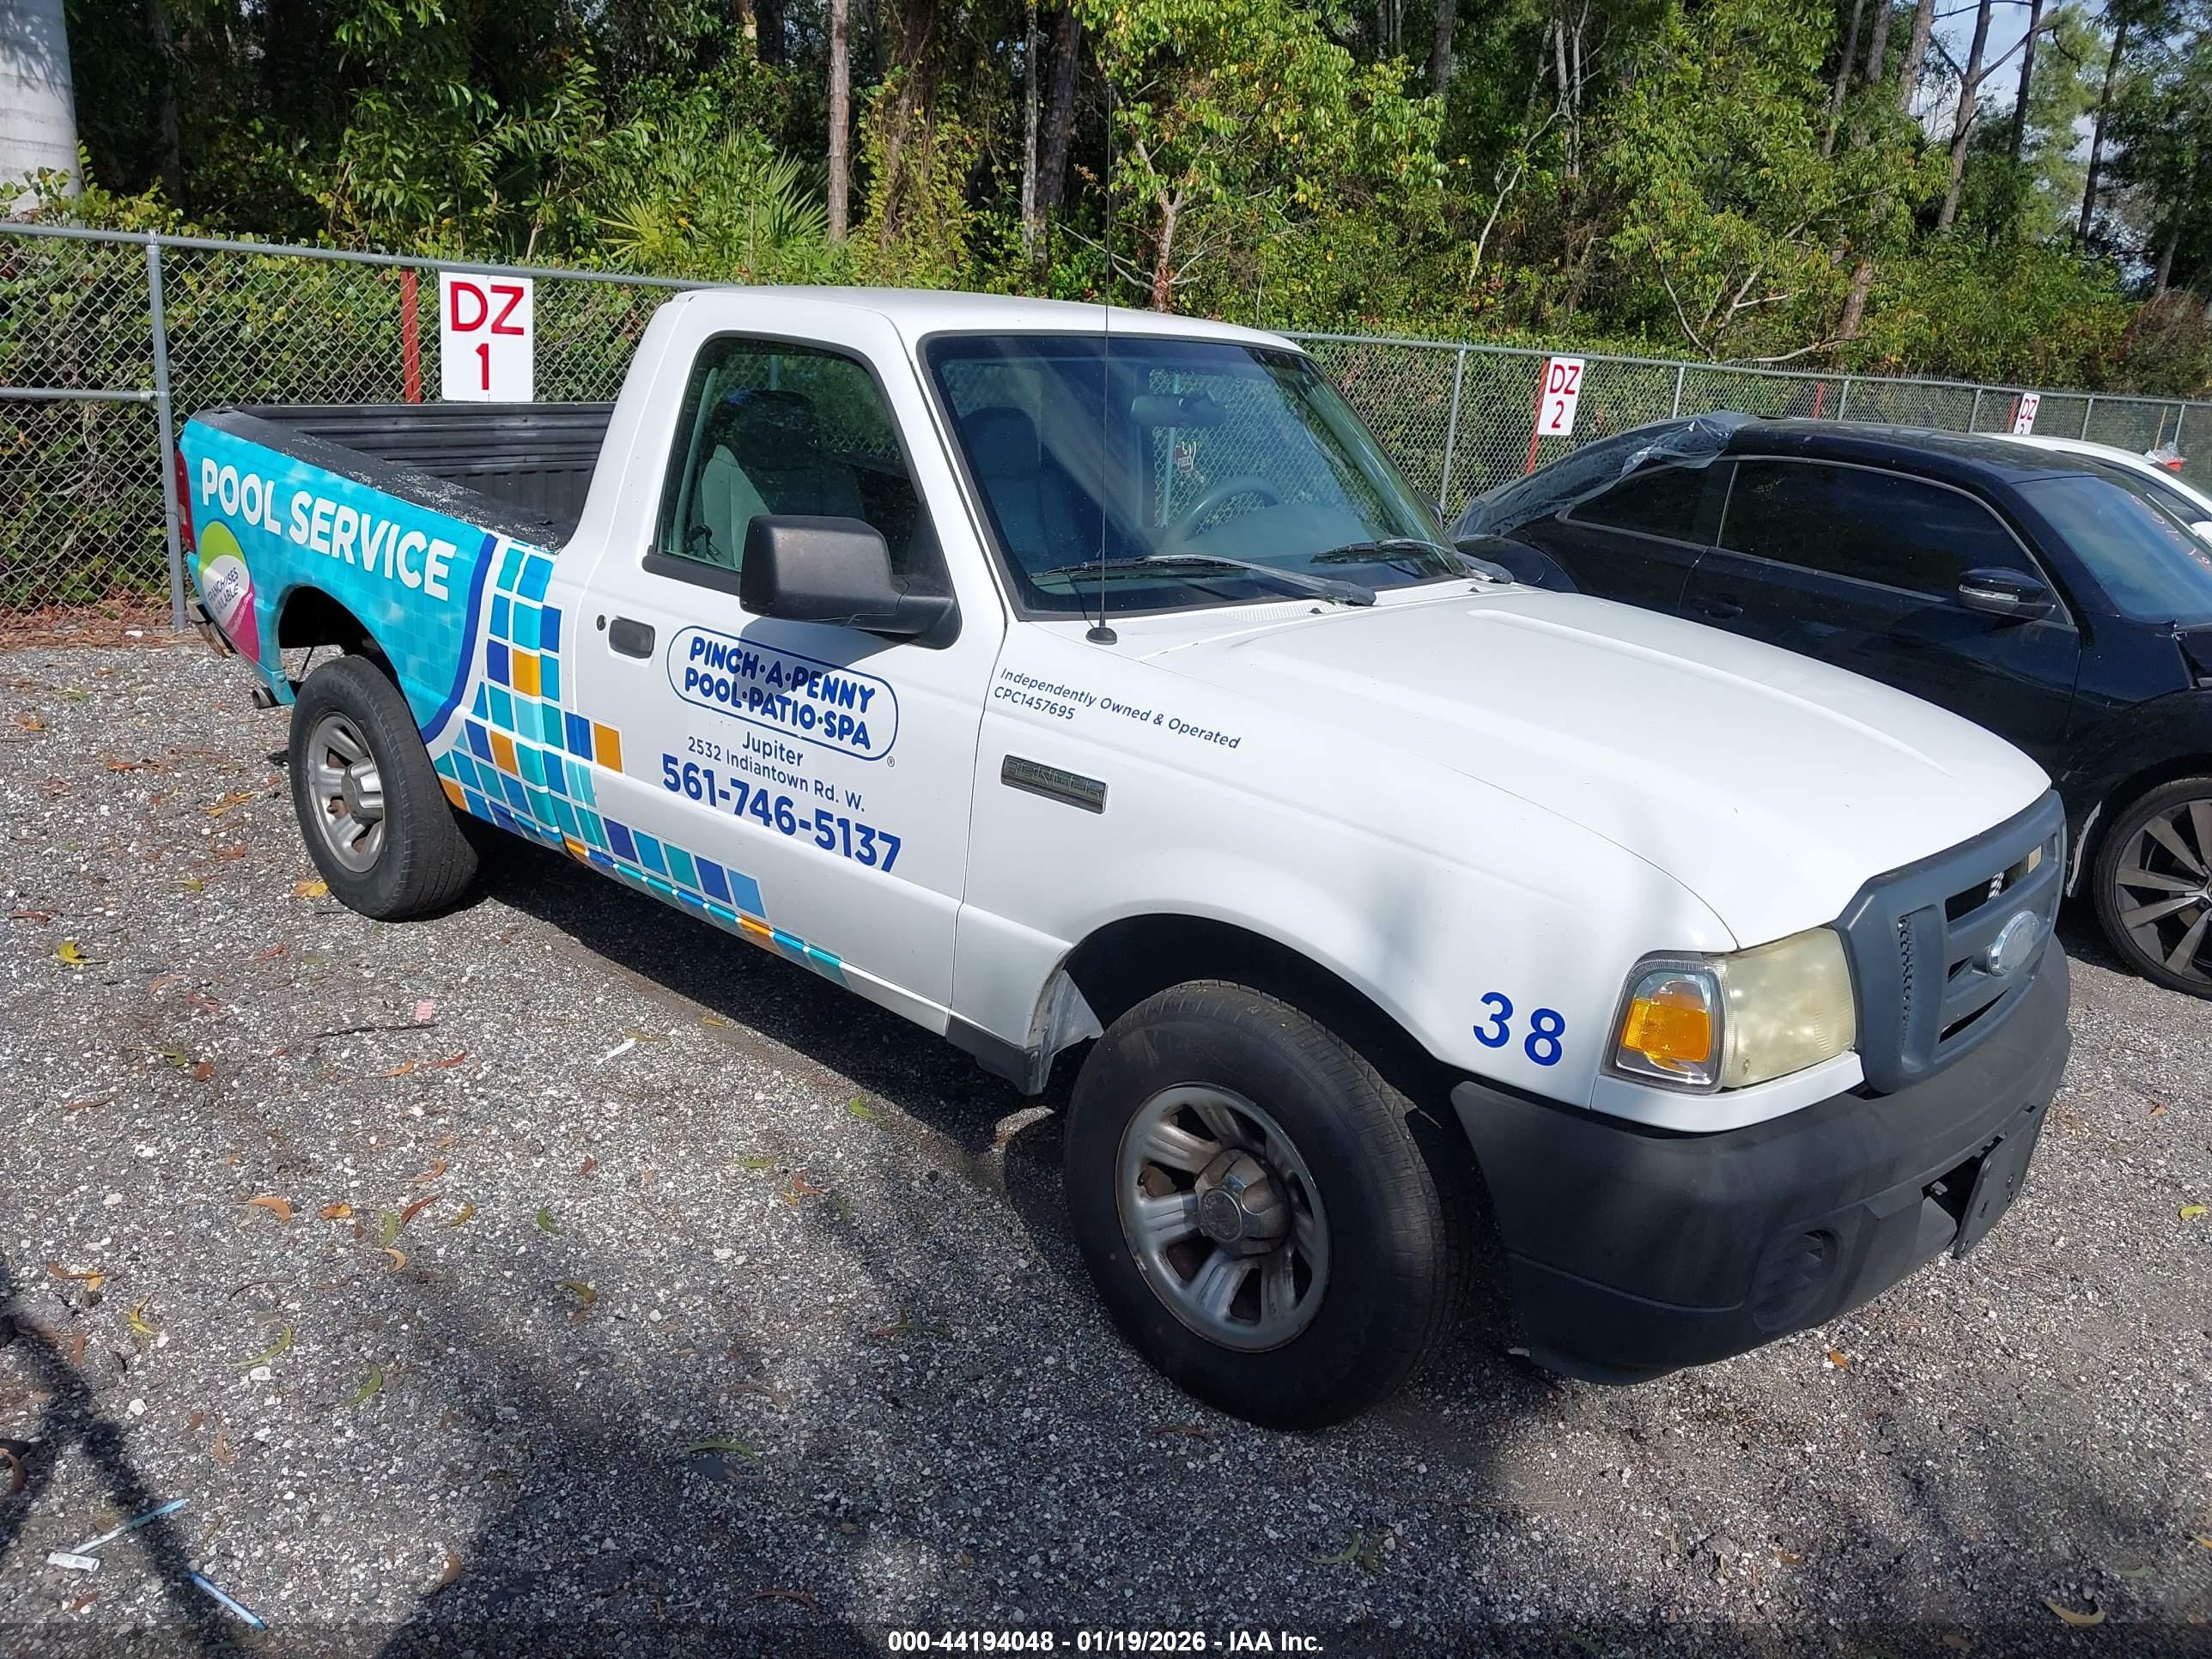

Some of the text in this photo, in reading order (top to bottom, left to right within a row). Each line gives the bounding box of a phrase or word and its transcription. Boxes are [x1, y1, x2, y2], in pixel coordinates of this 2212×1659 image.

[451, 281, 525, 336] DZ
[475, 343, 489, 390] 1
[1549, 364, 1580, 395] DZ
[1552, 400, 1565, 428] 2
[2020, 398, 2038, 420] DZ
[202, 458, 458, 600] POOL SERVICE
[994, 687, 1076, 720] CPC1457695
[1000, 668, 1242, 750] Independently Owned & Operated
[688, 736, 865, 812] 2532 Indiantown Rd. W.
[742, 732, 804, 767] Jupiter
[662, 753, 902, 872] 561-746-5137
[1473, 992, 1566, 1066] 38
